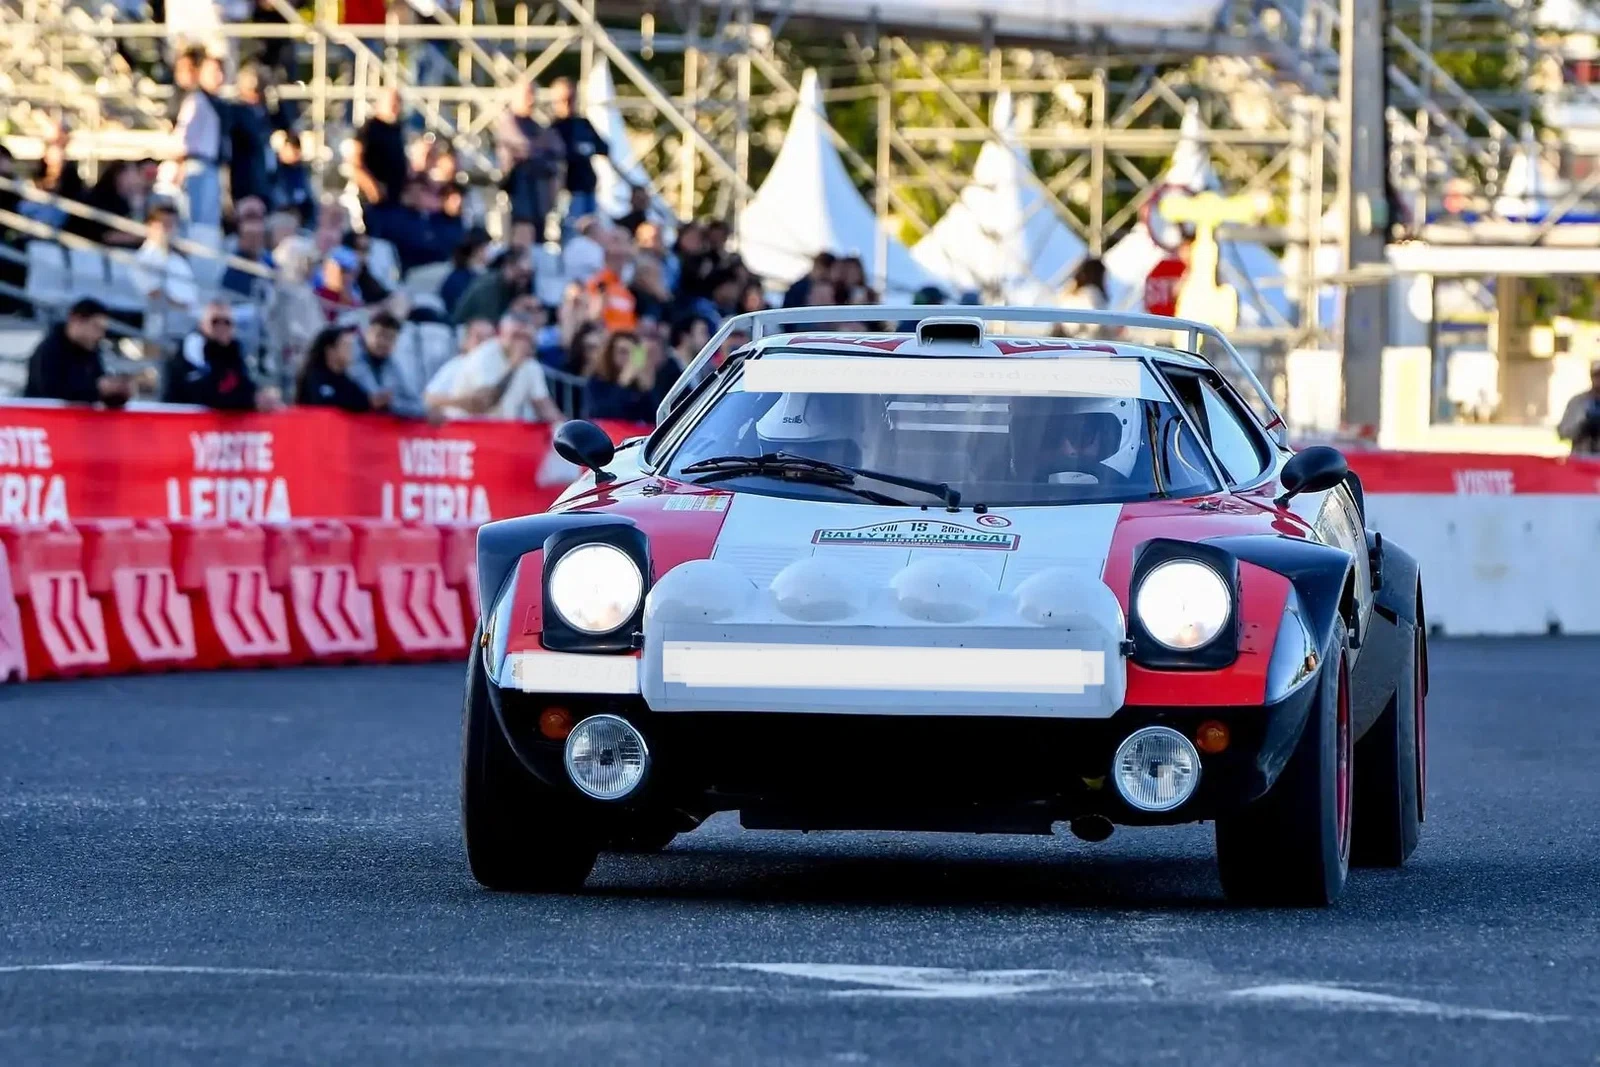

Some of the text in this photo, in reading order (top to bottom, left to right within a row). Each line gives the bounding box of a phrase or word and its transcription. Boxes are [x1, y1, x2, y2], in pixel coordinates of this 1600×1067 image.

[0, 473, 70, 526] RIA
[910, 522, 928, 532] 15
[941, 525, 965, 534] 2024
[913, 533, 1011, 543] PORTUGAL
